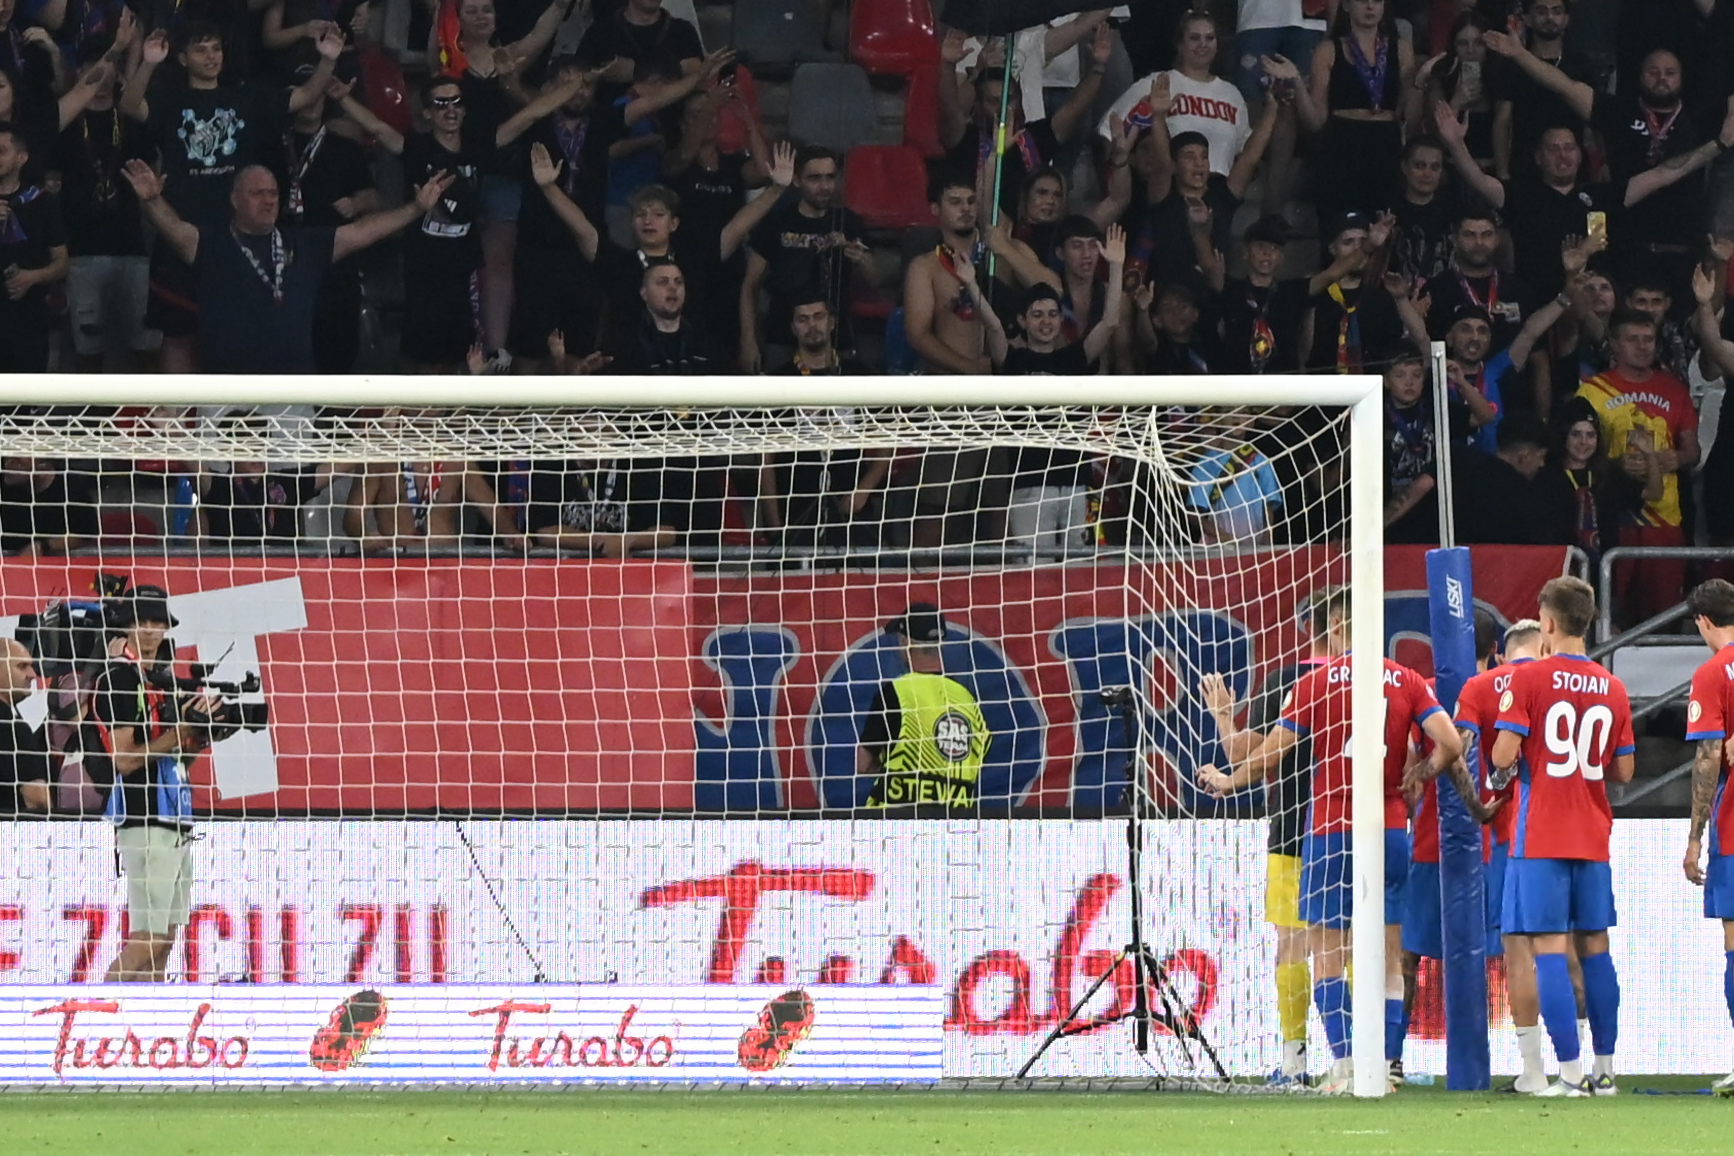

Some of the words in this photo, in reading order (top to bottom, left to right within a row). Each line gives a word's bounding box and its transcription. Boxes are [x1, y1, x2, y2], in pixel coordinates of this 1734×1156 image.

[1605, 391, 1671, 413] ROMANIA
[1446, 574, 1464, 619] LISKI
[1329, 668, 1402, 687] GRAC
[1552, 670, 1610, 696] STOIAN
[938, 720, 970, 738] SAS
[1544, 700, 1614, 781] 90
[887, 776, 976, 809] STEWA
[468, 999, 674, 1073] Turabo
